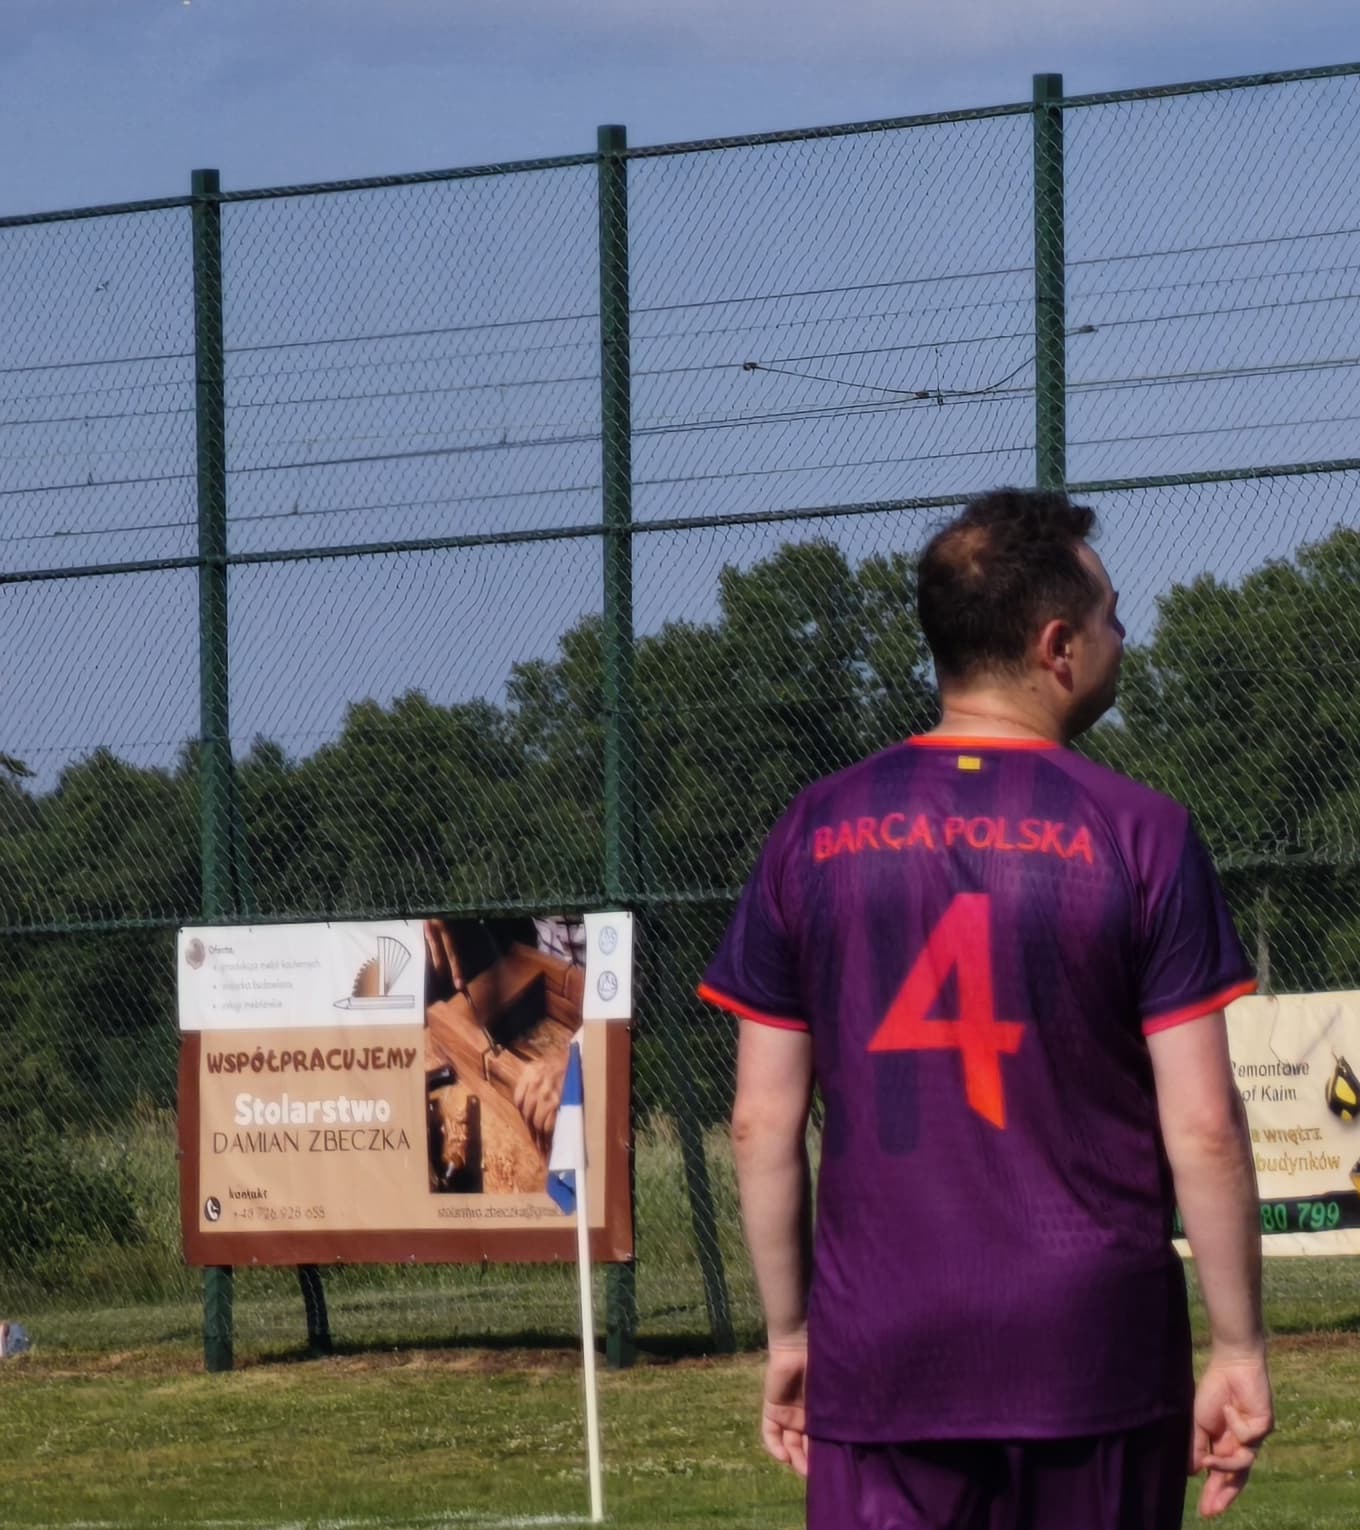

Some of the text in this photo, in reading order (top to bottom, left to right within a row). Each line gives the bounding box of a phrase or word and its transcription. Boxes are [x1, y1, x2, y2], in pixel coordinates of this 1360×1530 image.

[943, 816, 1095, 865] POLSKA
[867, 892, 1026, 1130] 4
[206, 1046, 417, 1074] WSPÓŁPRACUJEMY
[234, 1092, 392, 1126] Stolarstwo
[213, 1128, 411, 1155] DAMIAN ZBECZKA
[1260, 1201, 1340, 1232] 80 799
